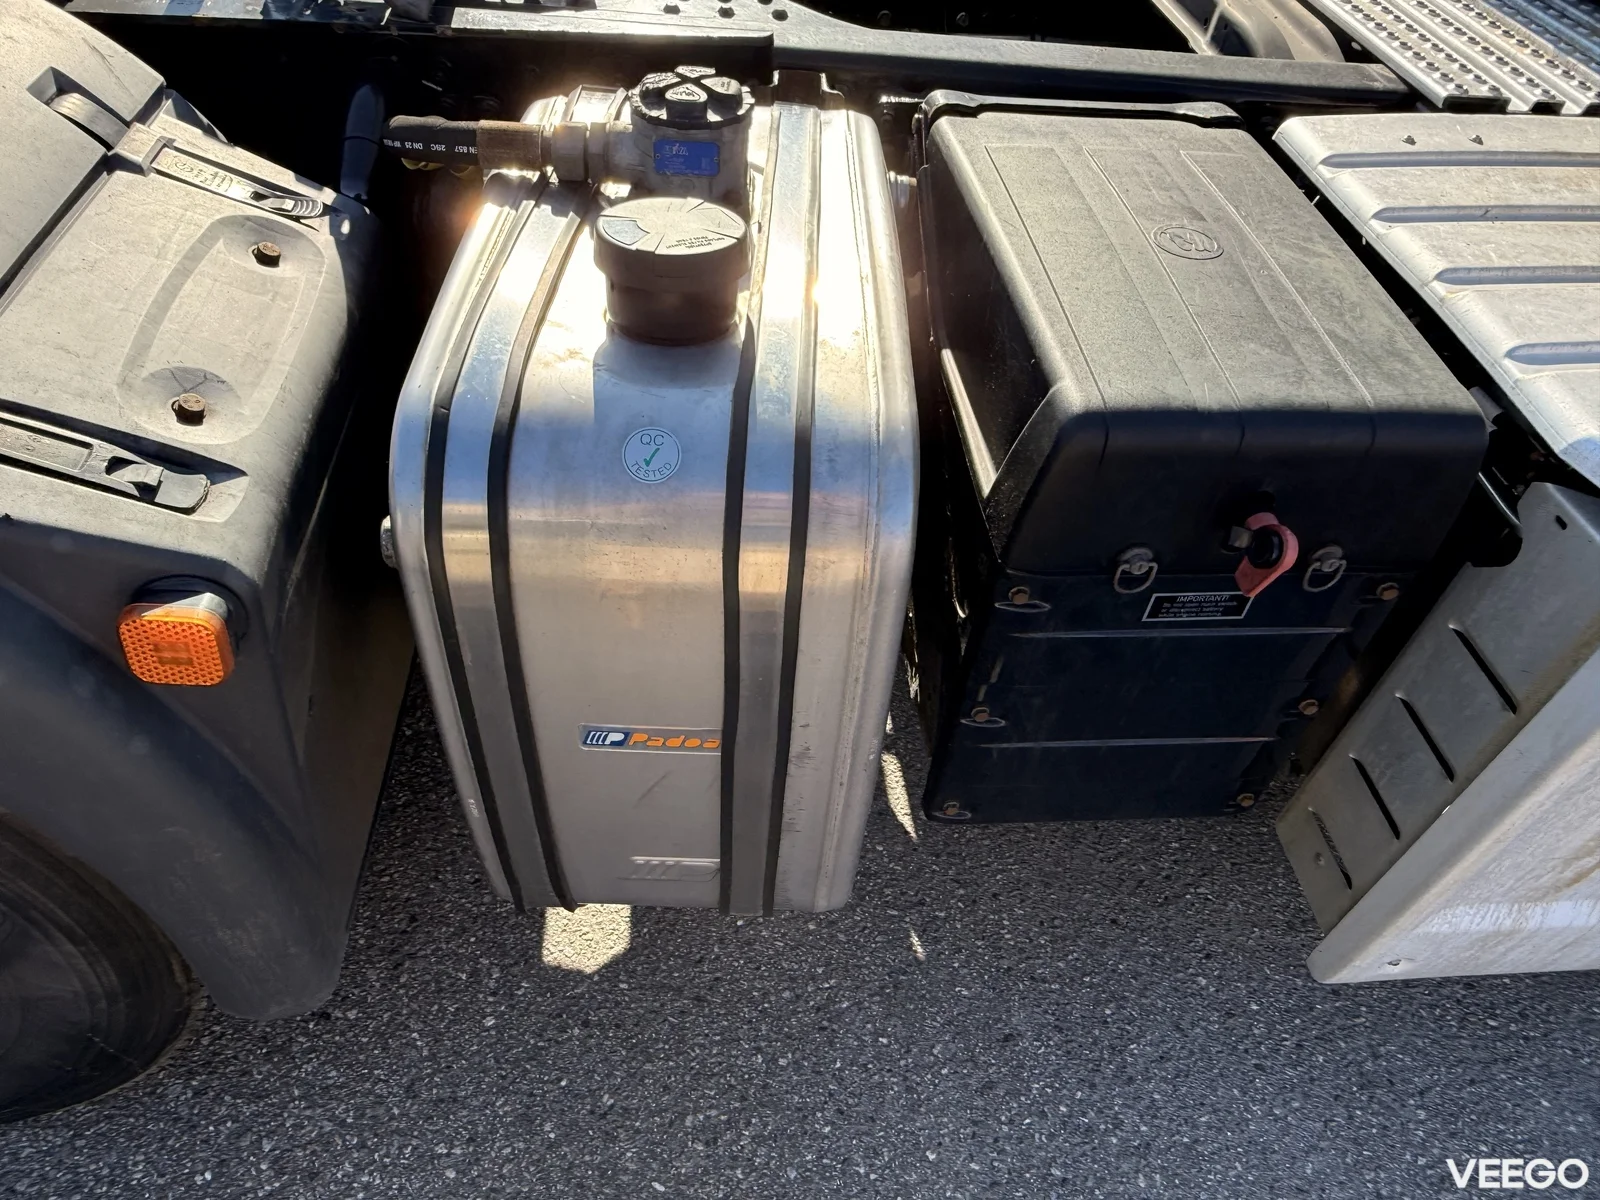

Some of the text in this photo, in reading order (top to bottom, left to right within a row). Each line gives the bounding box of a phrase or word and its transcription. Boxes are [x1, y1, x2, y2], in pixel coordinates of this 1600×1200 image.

[404, 141, 412, 149] 25
[413, 142, 423, 150] DN
[454, 145, 468, 153] 857
[640, 433, 665, 447] QC
[631, 460, 672, 478] TESTED
